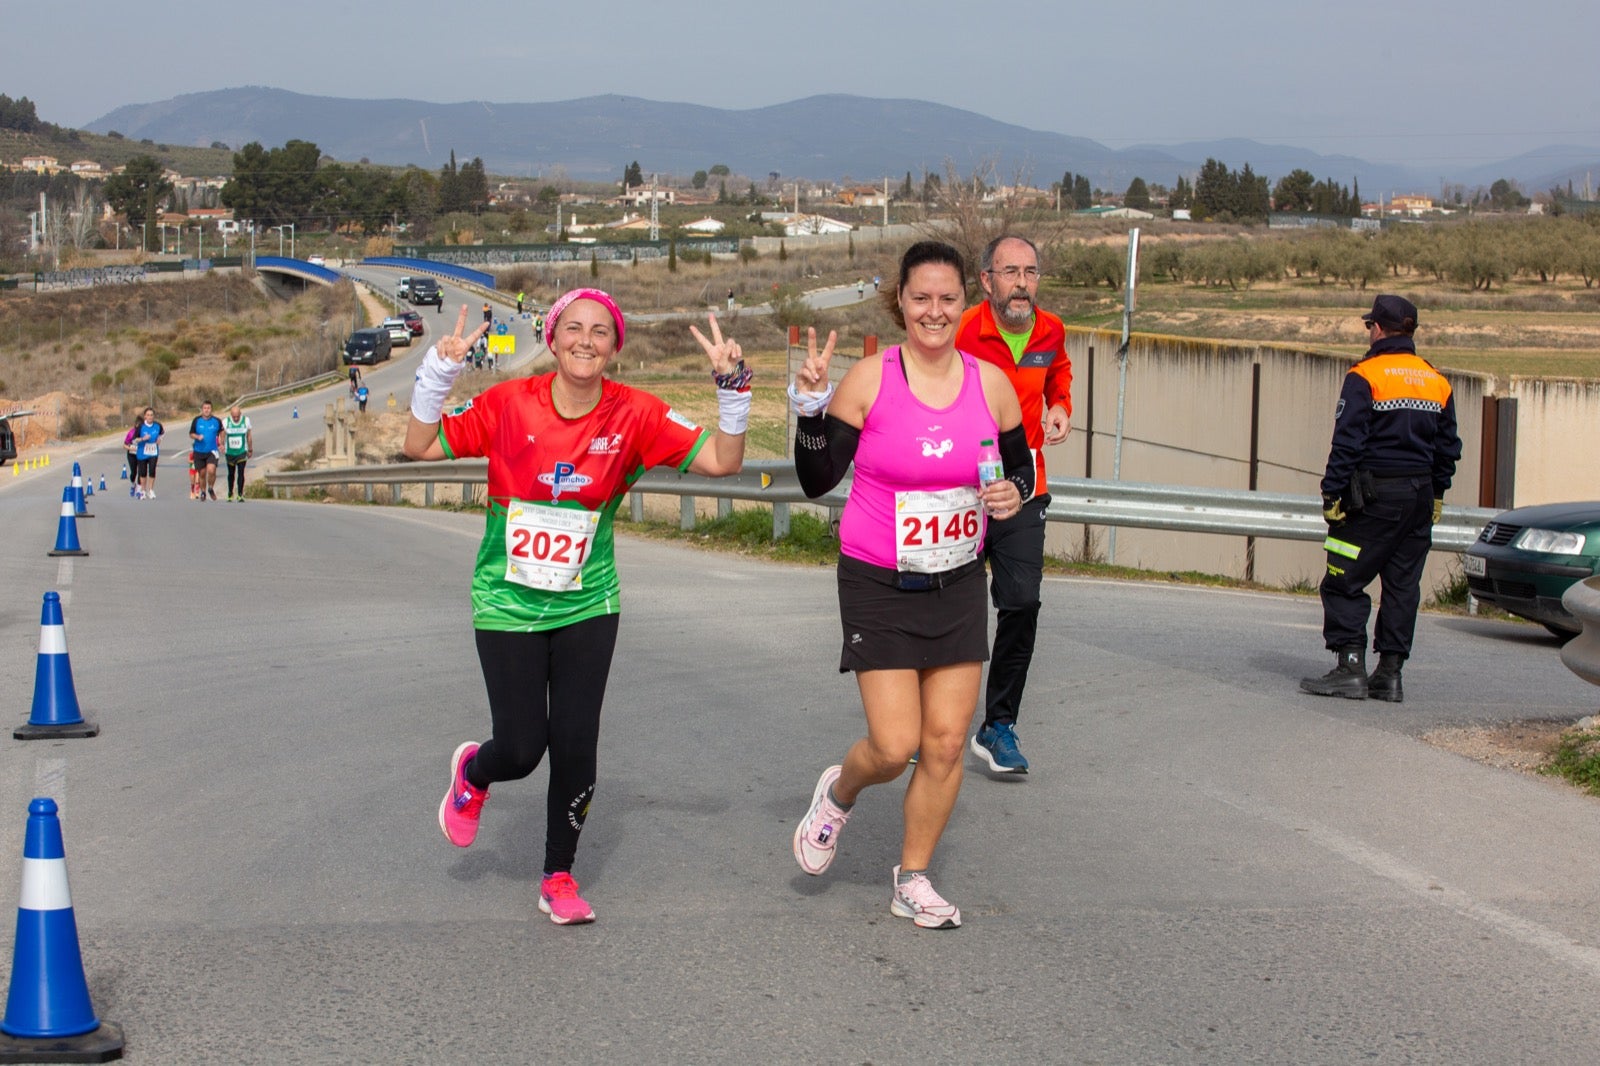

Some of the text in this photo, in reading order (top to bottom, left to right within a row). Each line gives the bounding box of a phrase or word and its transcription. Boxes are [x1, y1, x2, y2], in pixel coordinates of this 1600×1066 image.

[903, 510, 978, 546] 2146
[512, 529, 588, 563] 2021
[570, 791, 586, 808] NEW
